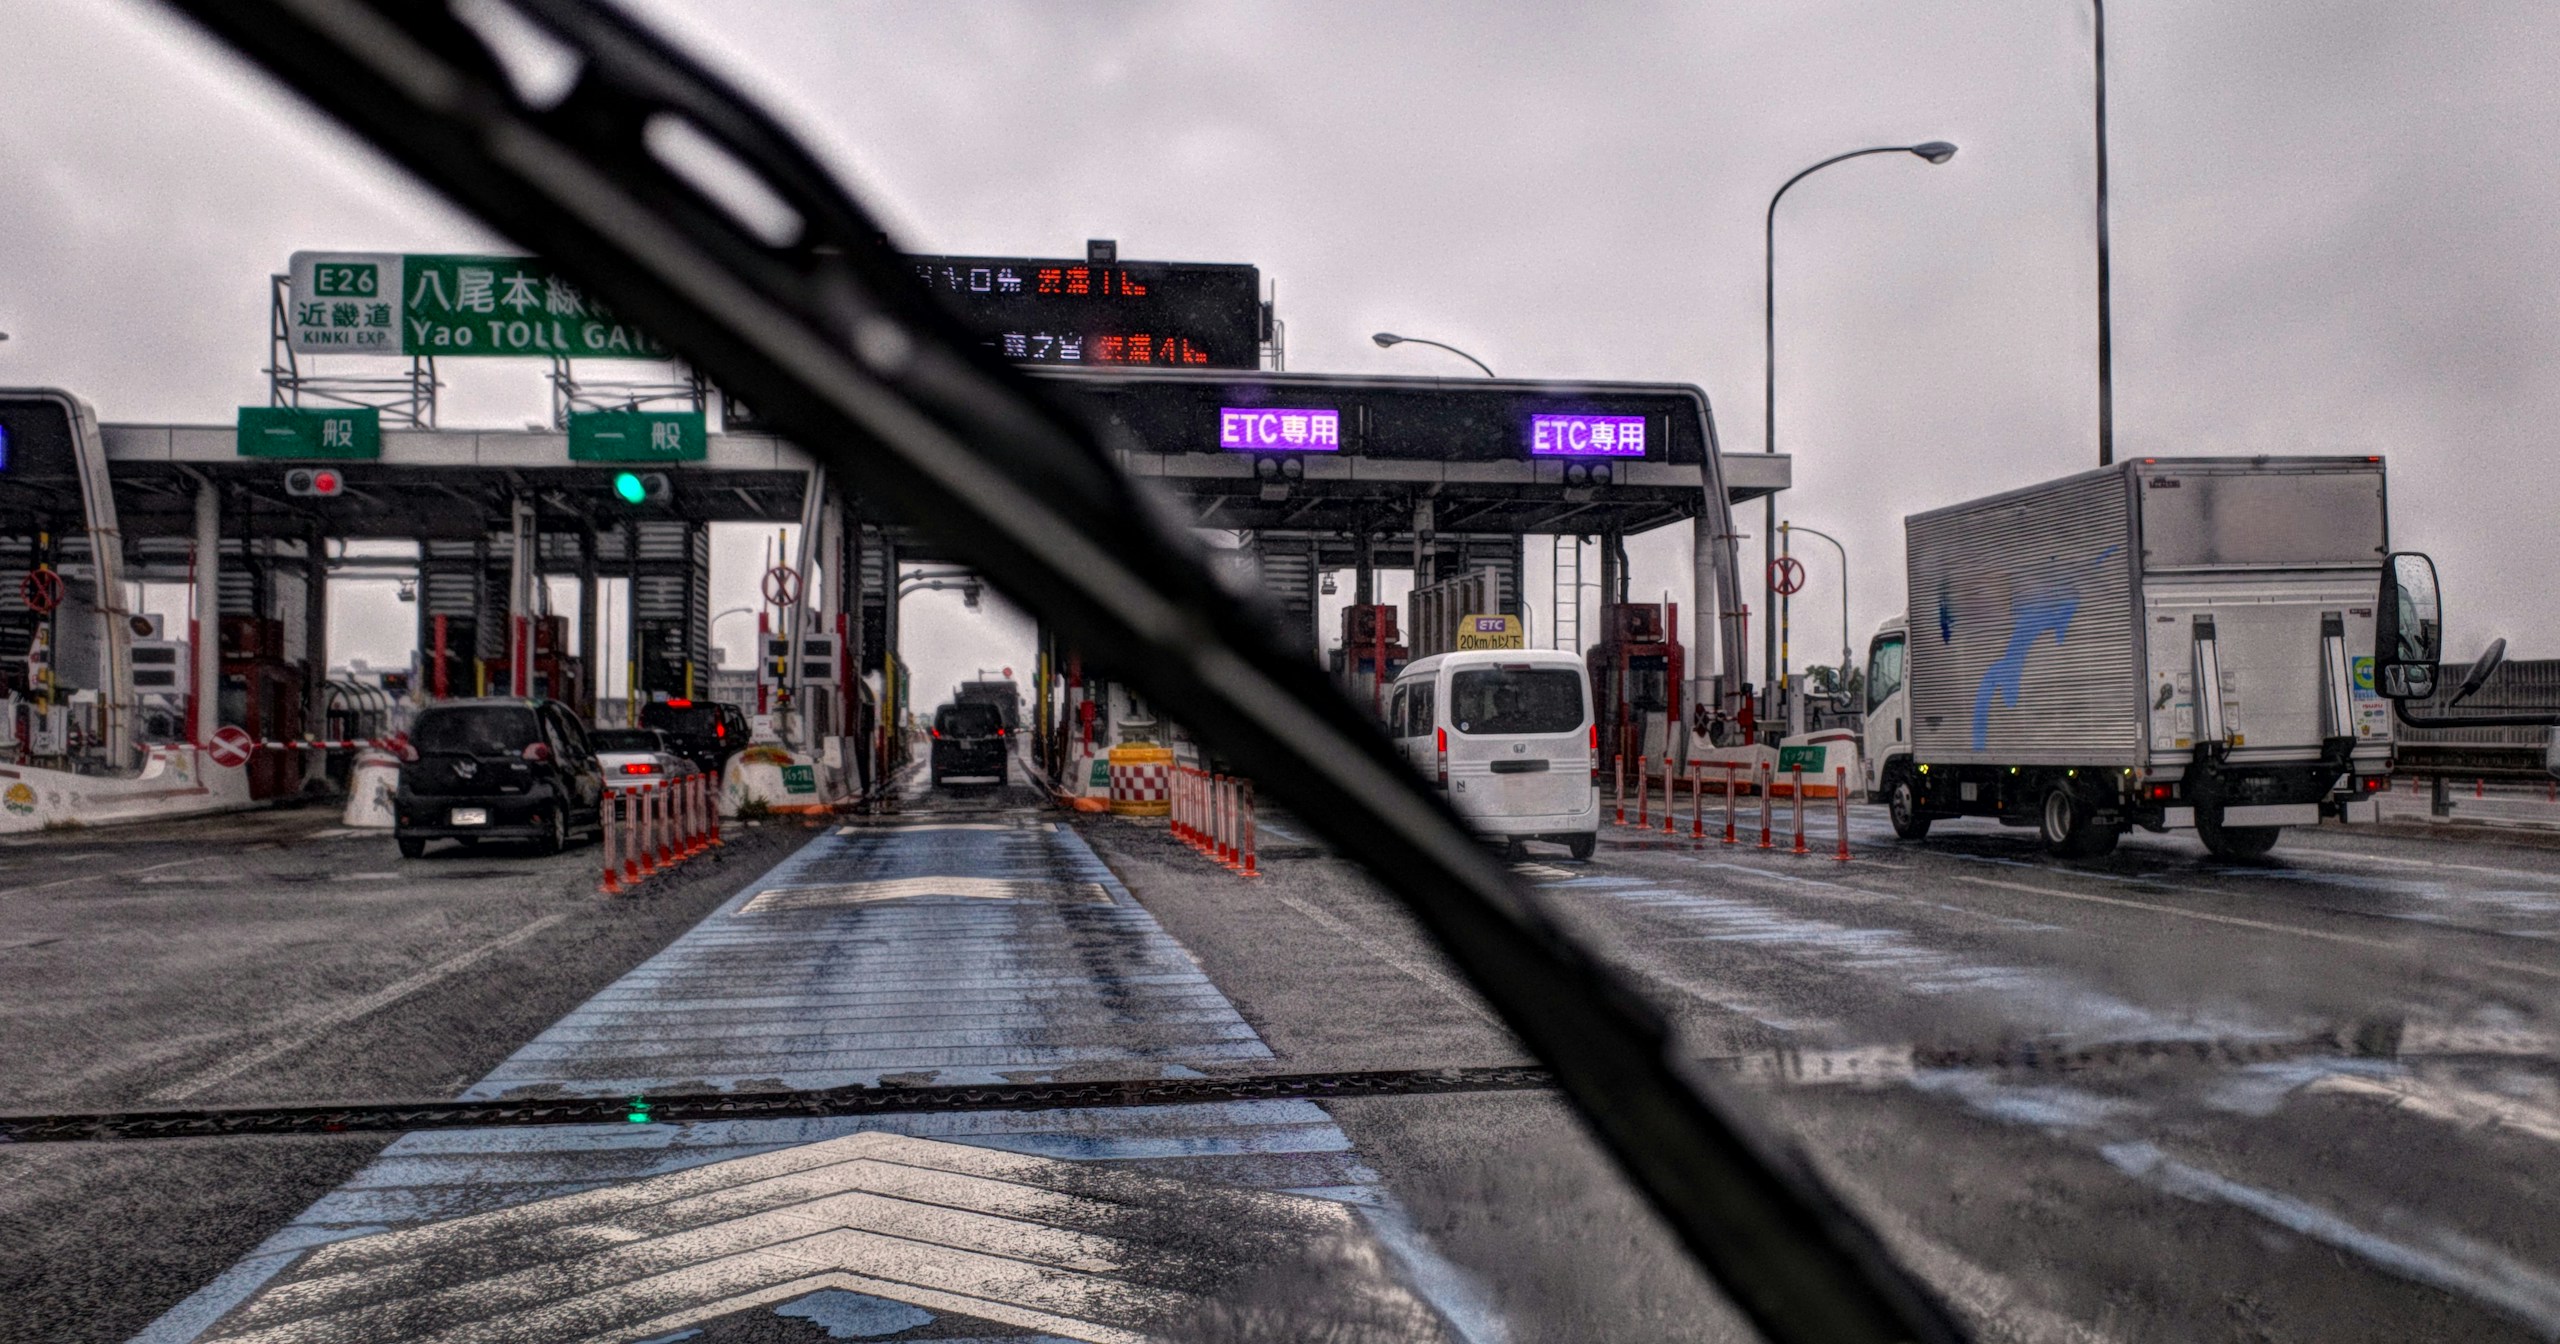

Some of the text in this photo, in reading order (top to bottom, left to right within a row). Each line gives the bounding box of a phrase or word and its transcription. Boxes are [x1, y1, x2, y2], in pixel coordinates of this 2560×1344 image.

[319, 268, 374, 292] E26
[408, 265, 612, 318] 八尾本線
[297, 301, 392, 328] 近畿道
[303, 331, 349, 344] KINKI
[407, 316, 473, 347] Yao
[488, 320, 570, 349] TOLL
[264, 418, 354, 448] 一般
[594, 421, 681, 450] 一般
[1222, 413, 1338, 445] ETC専用
[1533, 420, 1645, 452] ETC専用
[1479, 620, 1503, 630] ETC
[1460, 635, 1521, 650] 20km/h以下
